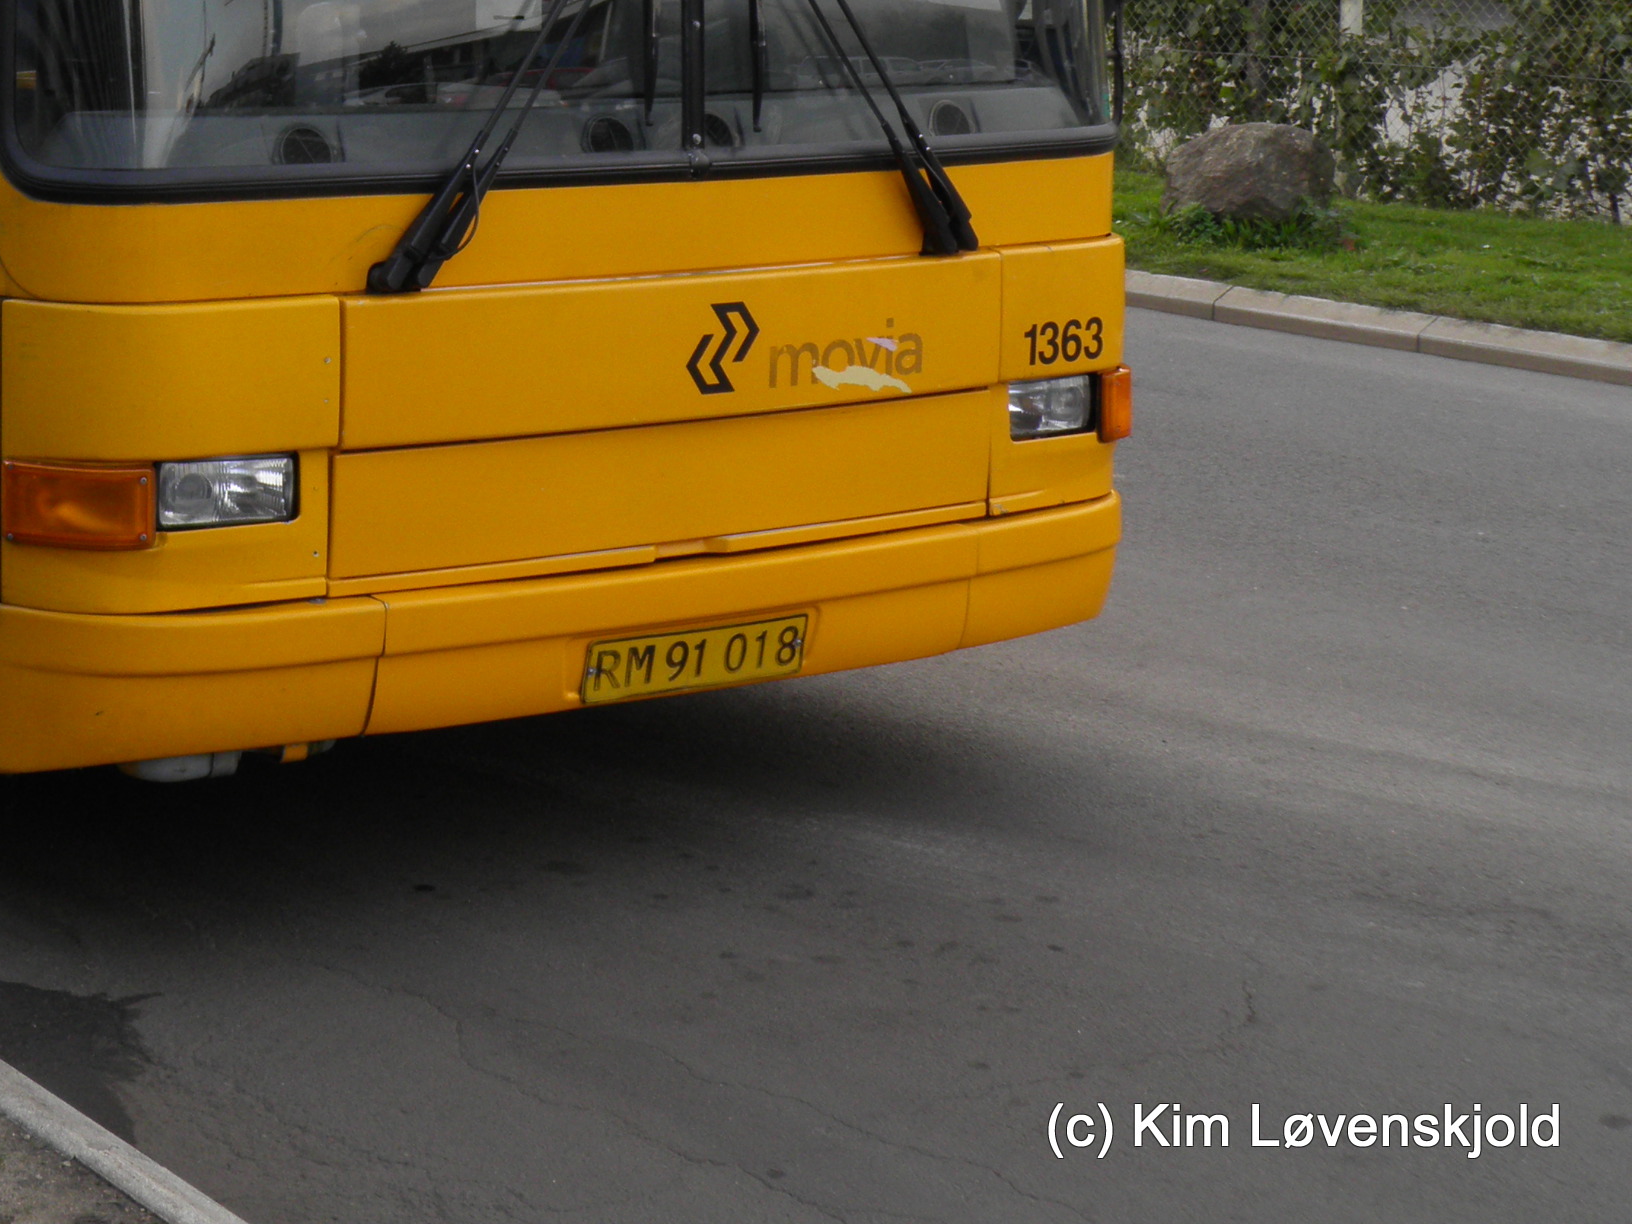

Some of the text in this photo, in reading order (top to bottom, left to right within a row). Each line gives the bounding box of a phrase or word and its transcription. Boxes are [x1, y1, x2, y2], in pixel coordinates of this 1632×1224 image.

[768, 317, 924, 389] movia
[1023, 317, 1104, 366] 1363
[592, 626, 799, 692] RM 91 018
